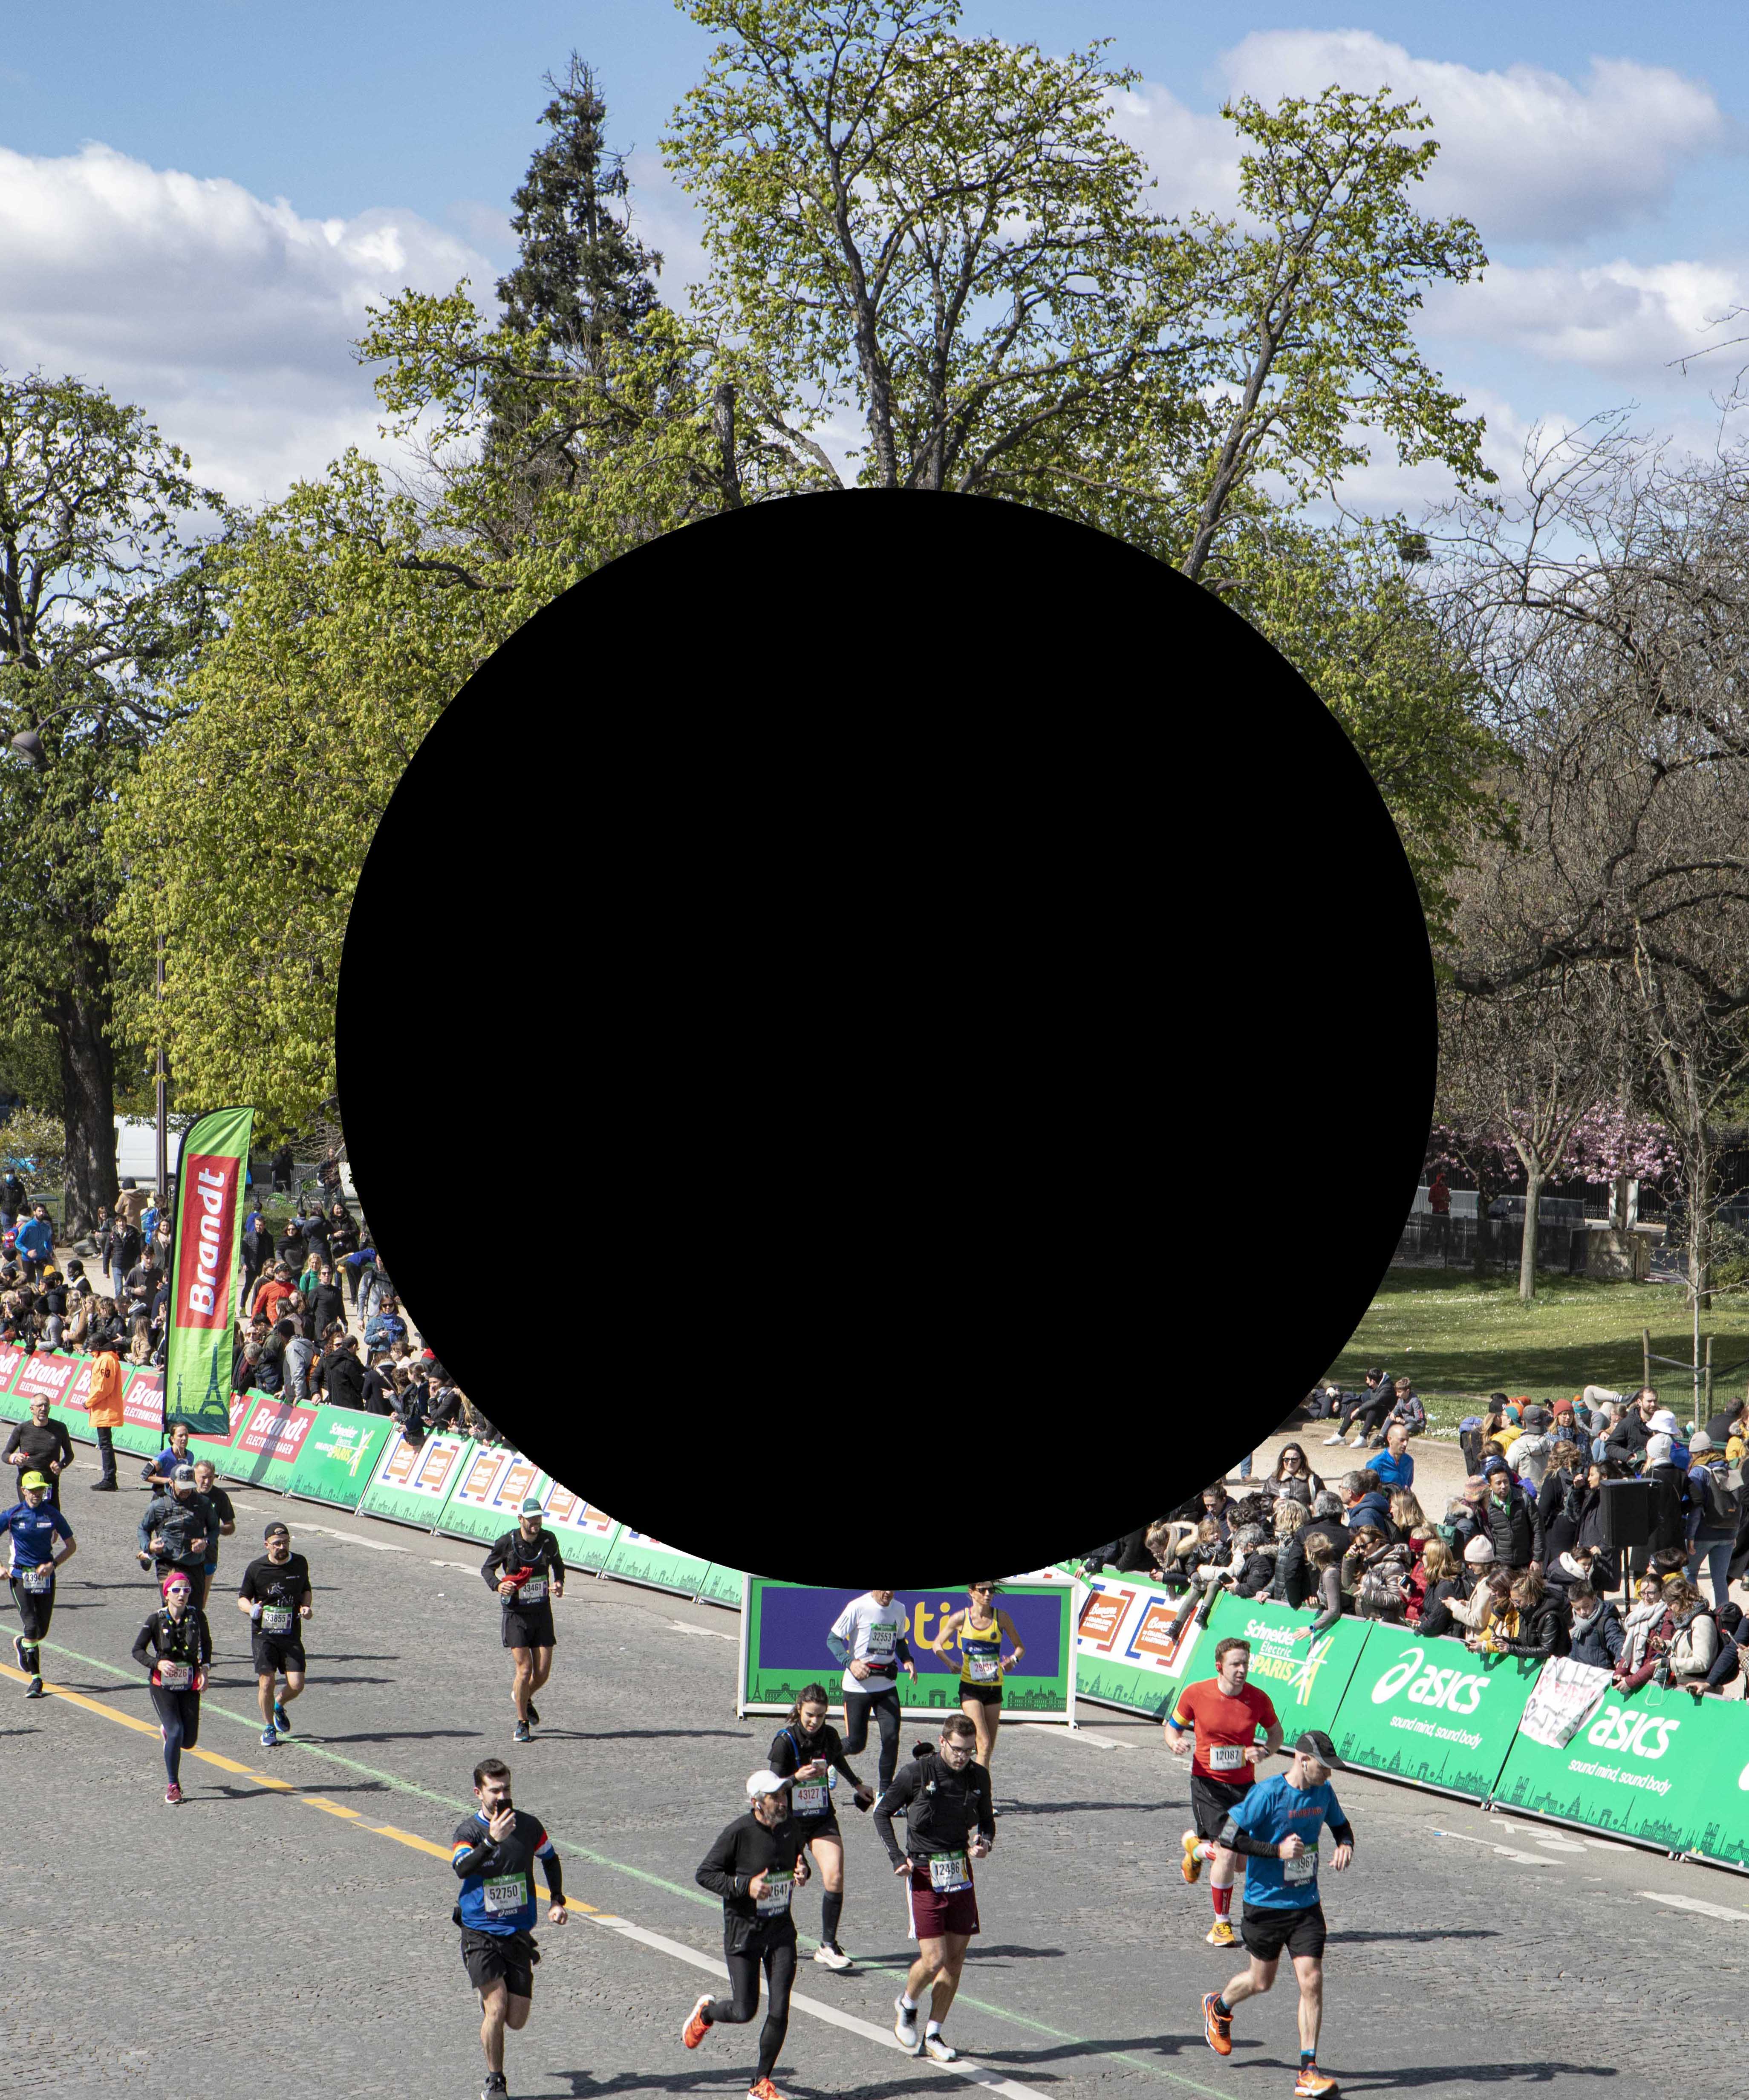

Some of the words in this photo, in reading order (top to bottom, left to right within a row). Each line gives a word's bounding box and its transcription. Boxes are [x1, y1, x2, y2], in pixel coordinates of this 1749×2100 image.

[189, 1168, 225, 1316] Brandt
[23, 1357, 72, 1387] Brandt
[127, 1381, 164, 1411] Bran
[124, 1406, 162, 1425] ELECTROMENAG
[250, 1408, 309, 1442] Brandt
[245, 1434, 294, 1455] ELECTROMENAGER
[523, 1584, 541, 1592] 33461
[266, 1613, 286, 1622] 33855
[873, 1632, 892, 1641] 32553
[1244, 1619, 1295, 1646] Schneider
[1260, 1641, 1292, 1657] Electric
[1252, 1655, 1295, 1681] PARIS
[1390, 1716, 1417, 1730] sound
[1413, 1720, 1437, 1737] mind,
[1434, 1726, 1463, 1742] sound
[1459, 1730, 1483, 1749] body
[1216, 1750, 1239, 1761] 12087
[1568, 1760, 1599, 1775] sound
[1595, 1764, 1621, 1783] mind,
[1619, 1771, 1651, 1788] sound
[1645, 1776, 1672, 1796] body
[798, 1788, 819, 1800] 43127
[490, 1885, 518, 1900] 52750
